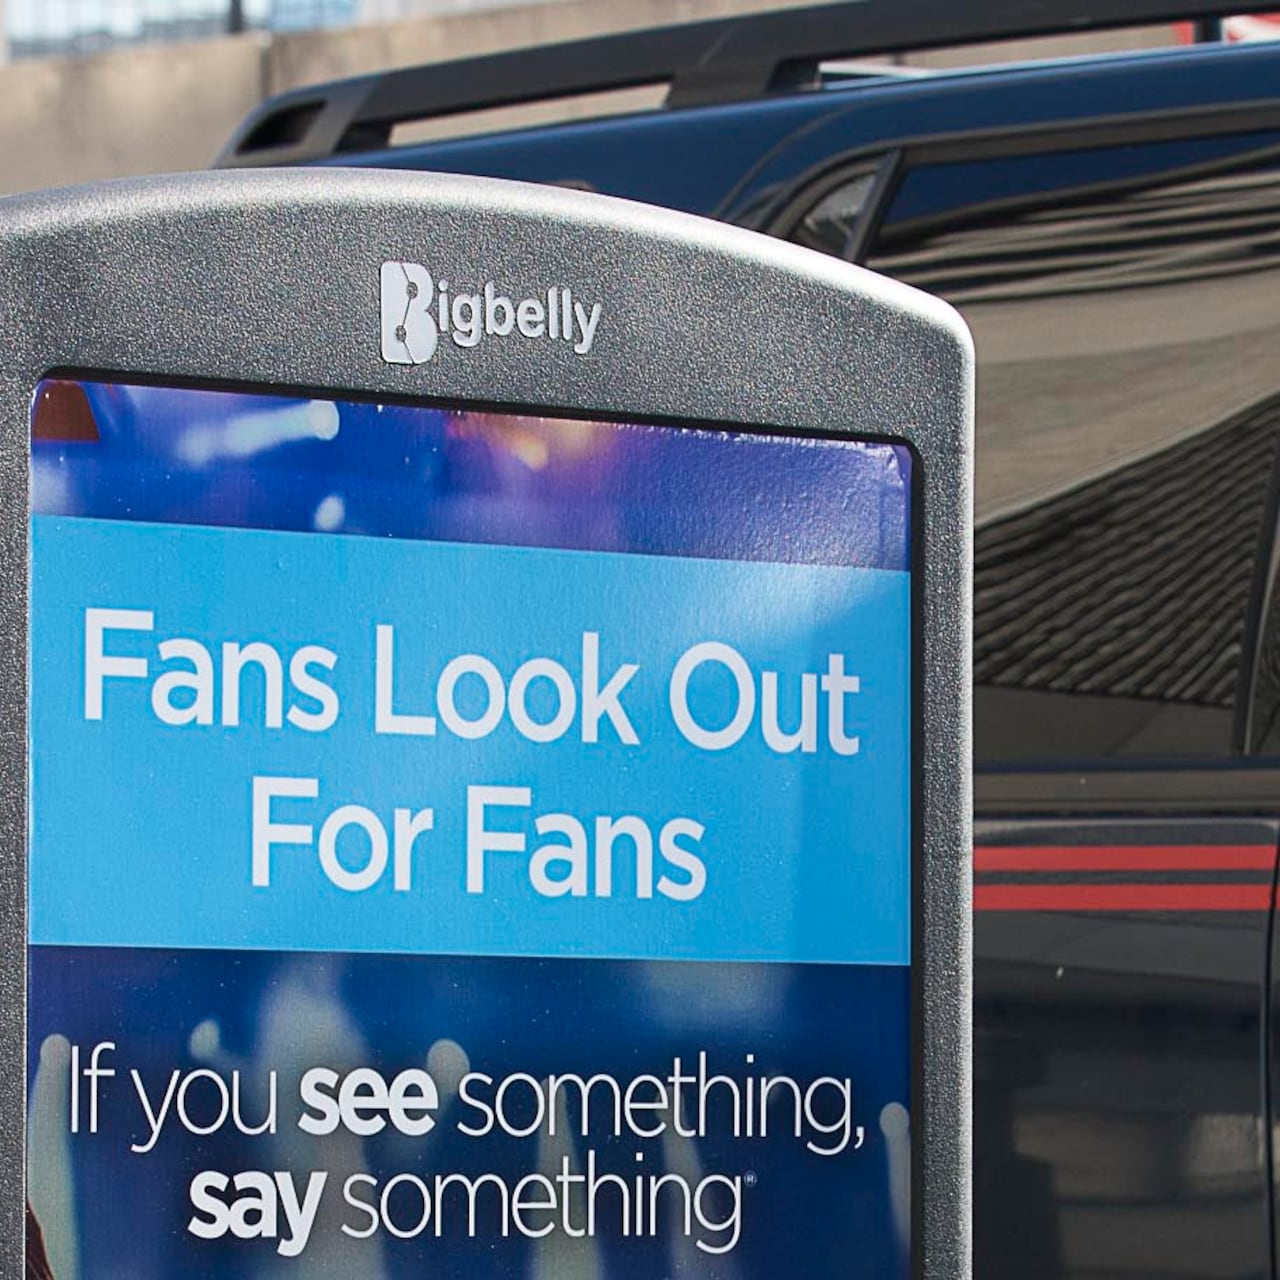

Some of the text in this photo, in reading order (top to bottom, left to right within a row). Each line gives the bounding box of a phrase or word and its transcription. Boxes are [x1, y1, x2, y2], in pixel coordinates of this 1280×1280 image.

[380, 260, 602, 365] Bigbelly
[83, 607, 861, 756] Fans Look Out
[250, 775, 708, 901] For Fans
[70, 1041, 866, 1157] If you see something,
[186, 1169, 330, 1258] say
